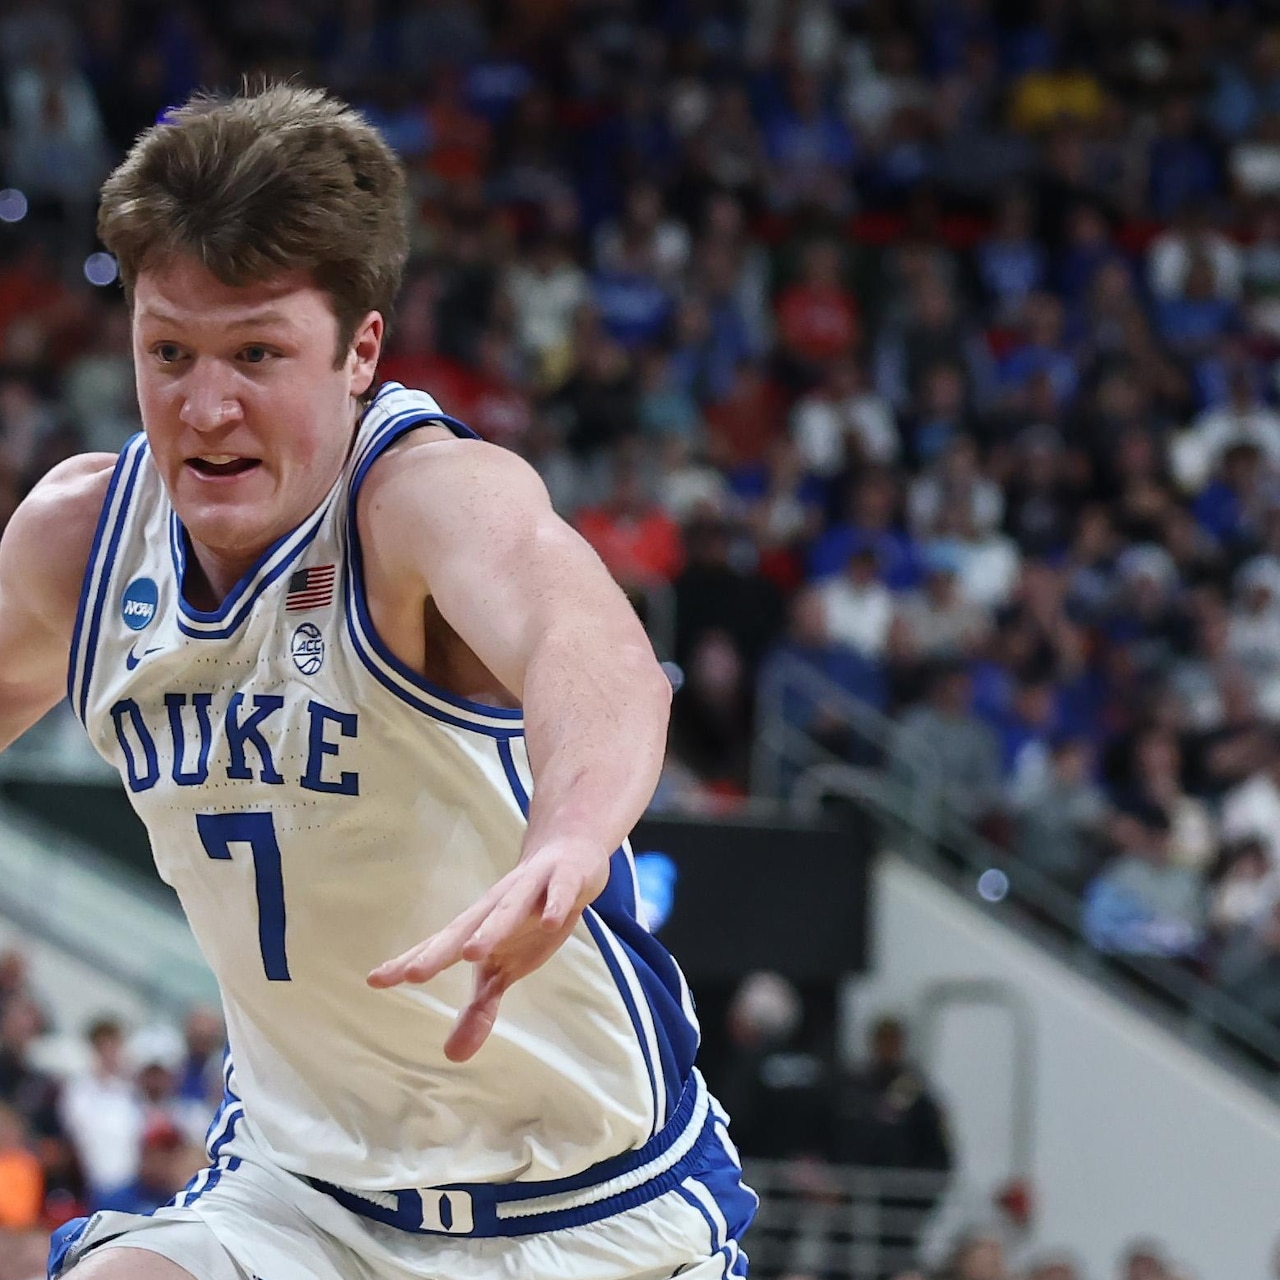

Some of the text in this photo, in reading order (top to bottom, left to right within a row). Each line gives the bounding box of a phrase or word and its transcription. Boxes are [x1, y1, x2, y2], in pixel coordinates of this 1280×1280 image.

[124, 600, 155, 617] NCAA
[296, 639, 323, 653] ACC
[110, 692, 360, 797] DUKE
[197, 811, 293, 982] 7
[417, 1189, 474, 1234] D
